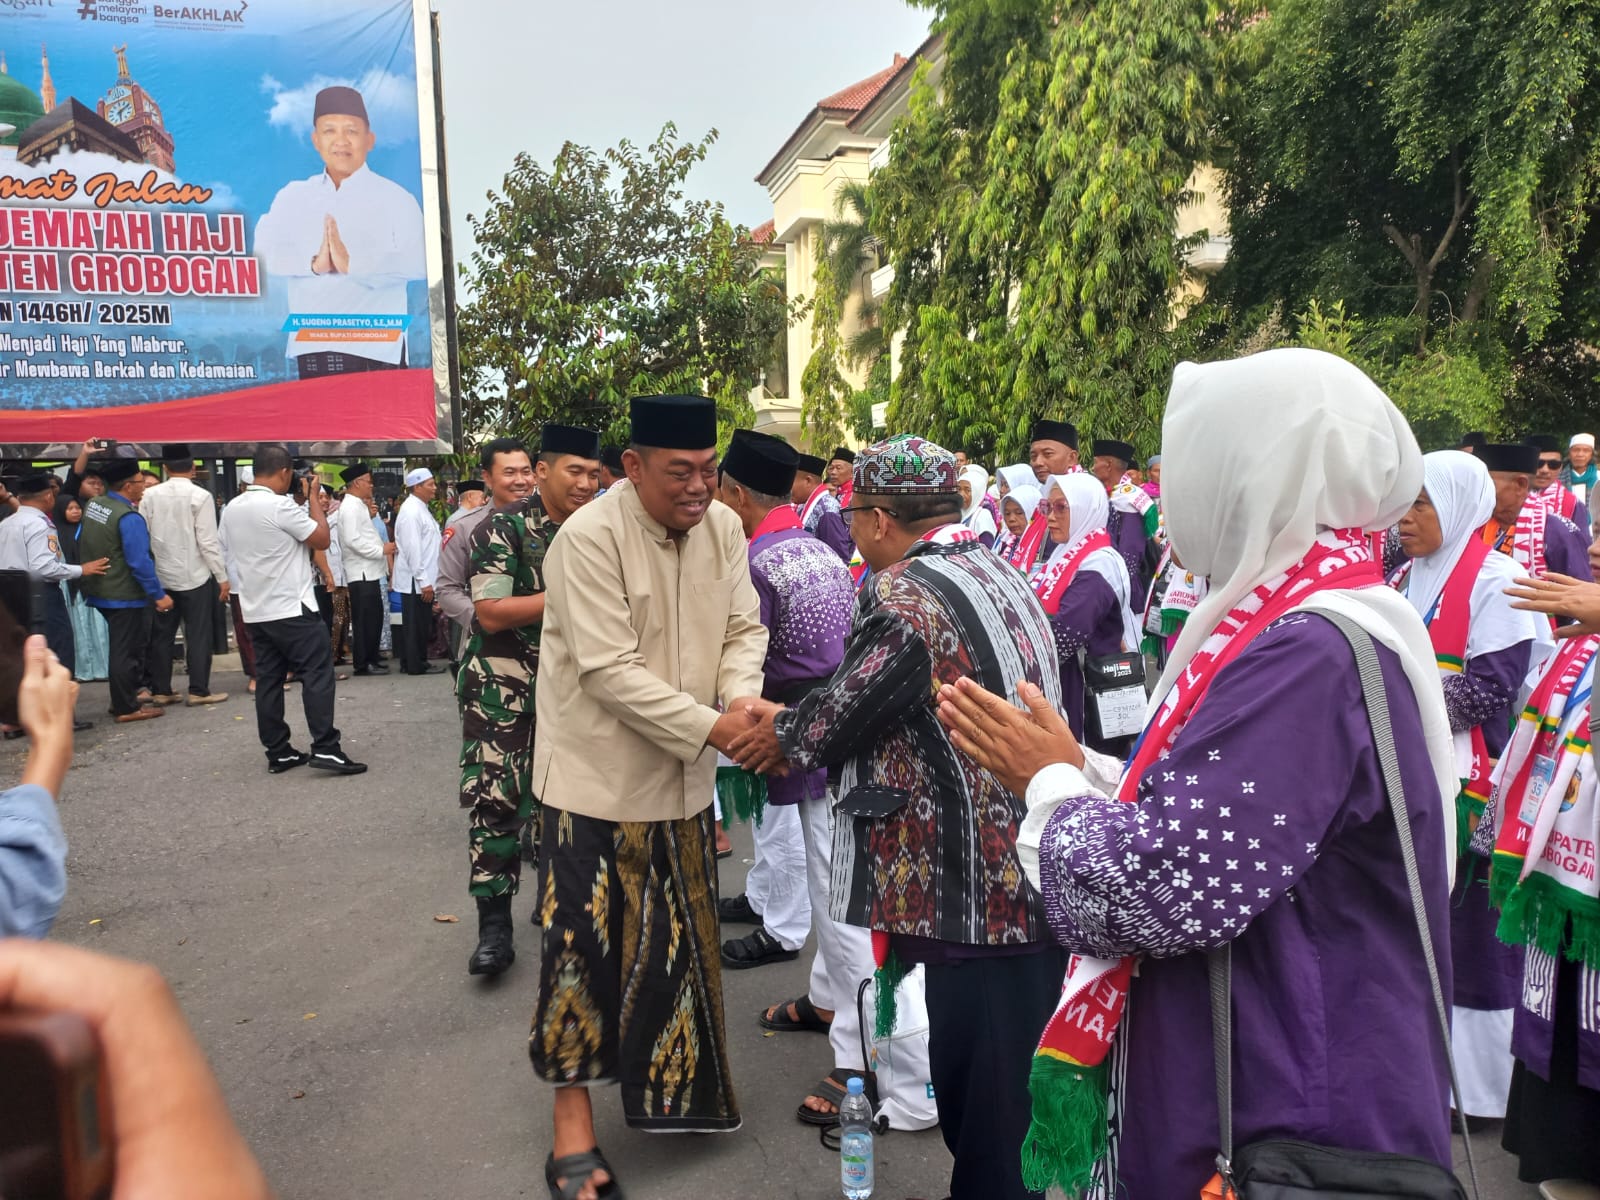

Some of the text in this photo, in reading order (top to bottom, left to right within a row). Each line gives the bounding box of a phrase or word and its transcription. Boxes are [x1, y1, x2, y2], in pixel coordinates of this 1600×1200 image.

[99, 5, 147, 15] melayani
[99, 13, 139, 24] bangsa
[153, 5, 244, 22] BerAKHLAK
[84, 170, 213, 208] Jalan
[161, 213, 246, 254] HAJI
[70, 254, 260, 296] GROBOGAN
[17, 301, 93, 324] 1446H/
[99, 304, 171, 325] 2025M
[0, 334, 188, 357] Menjadi Haji Yang Mabrur,
[95, 361, 145, 379] Berkah
[149, 361, 175, 379] dan
[179, 361, 258, 379] Kedamaian.
